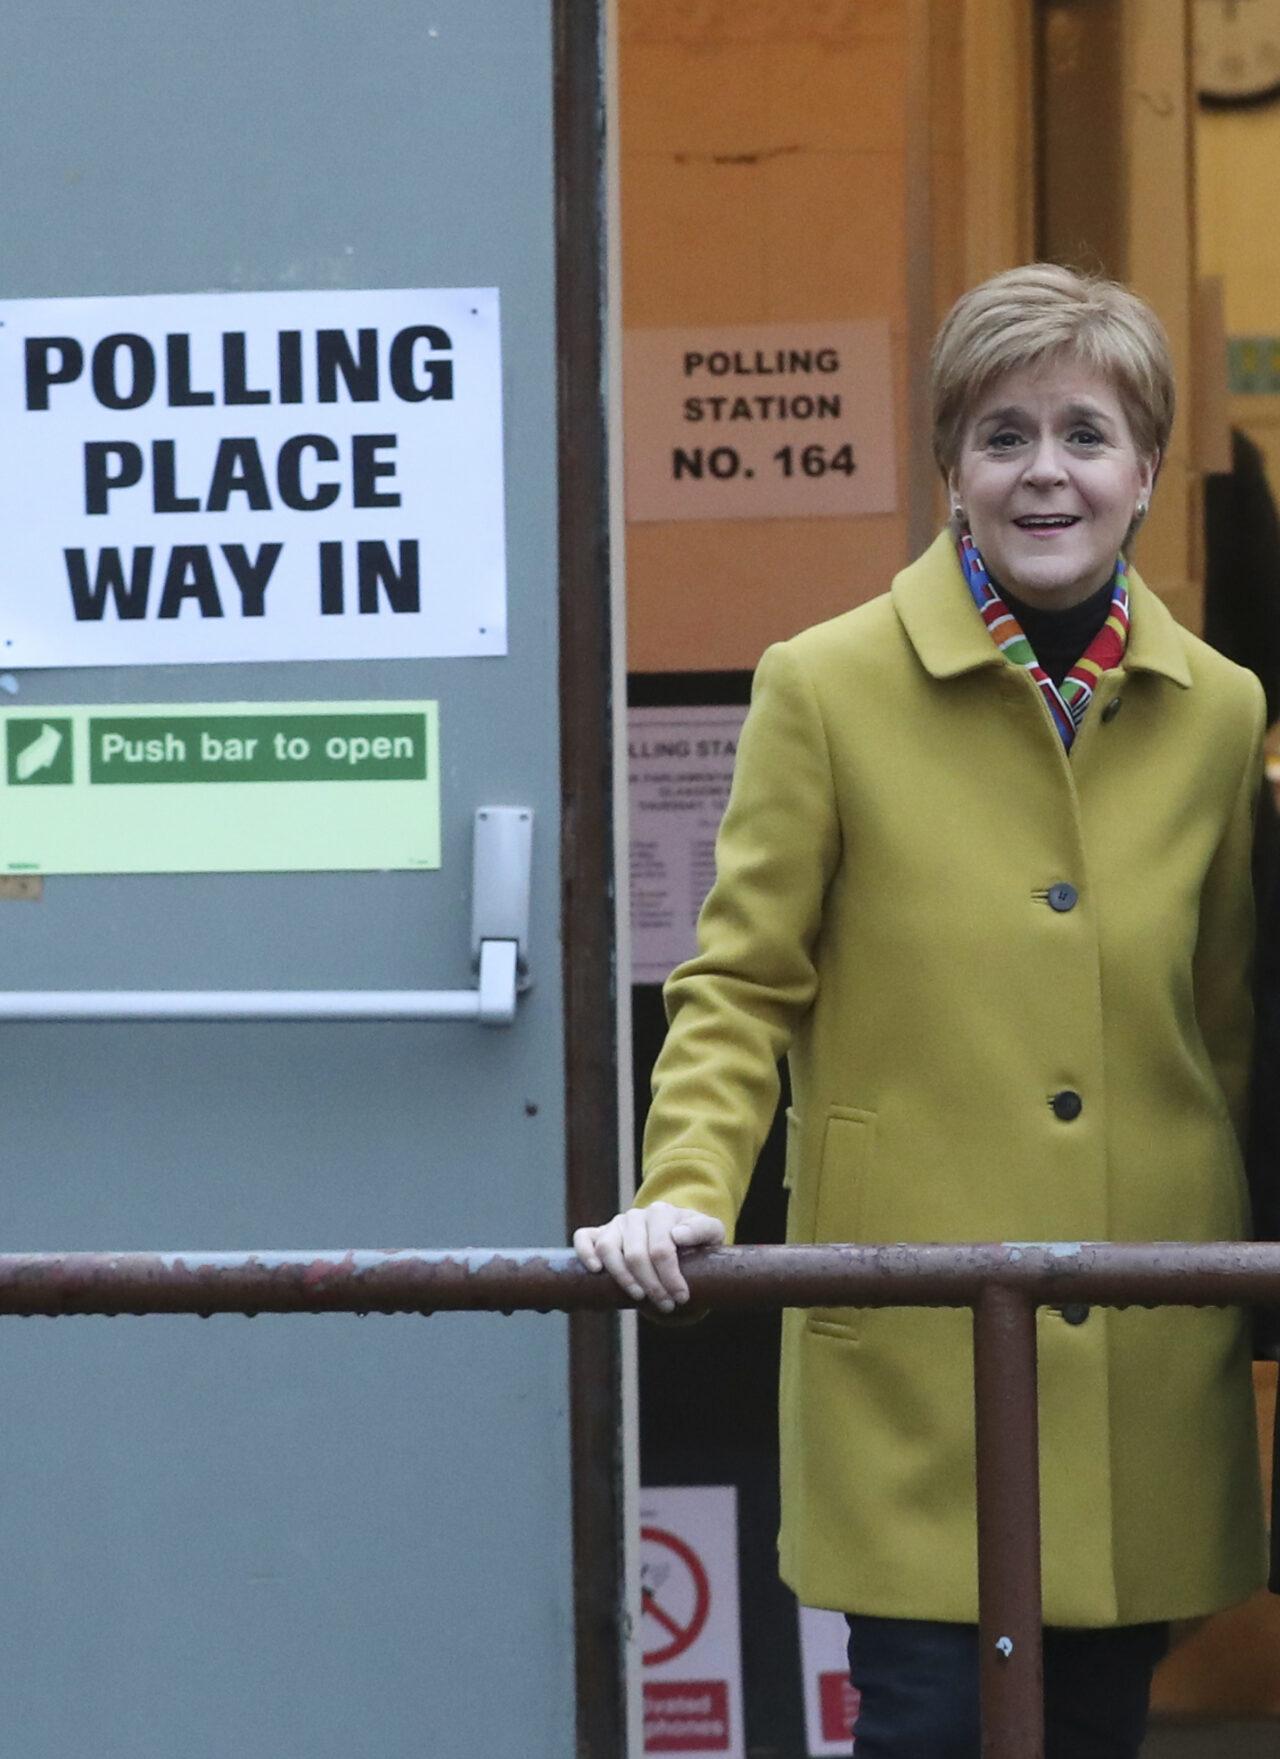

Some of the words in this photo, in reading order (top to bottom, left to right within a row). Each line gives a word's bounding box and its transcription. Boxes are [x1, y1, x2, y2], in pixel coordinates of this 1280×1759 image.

[24, 325, 454, 411] POLLING
[683, 349, 840, 377] POLLING
[683, 394, 841, 422] STATION
[84, 434, 402, 516] PLACE
[671, 446, 755, 480] NO.
[773, 444, 857, 479] 164
[63, 542, 284, 622] WAY
[319, 539, 421, 616] IN
[101, 733, 186, 762] Push
[201, 732, 259, 762] bar
[273, 732, 310, 761] to
[325, 735, 414, 765] open
